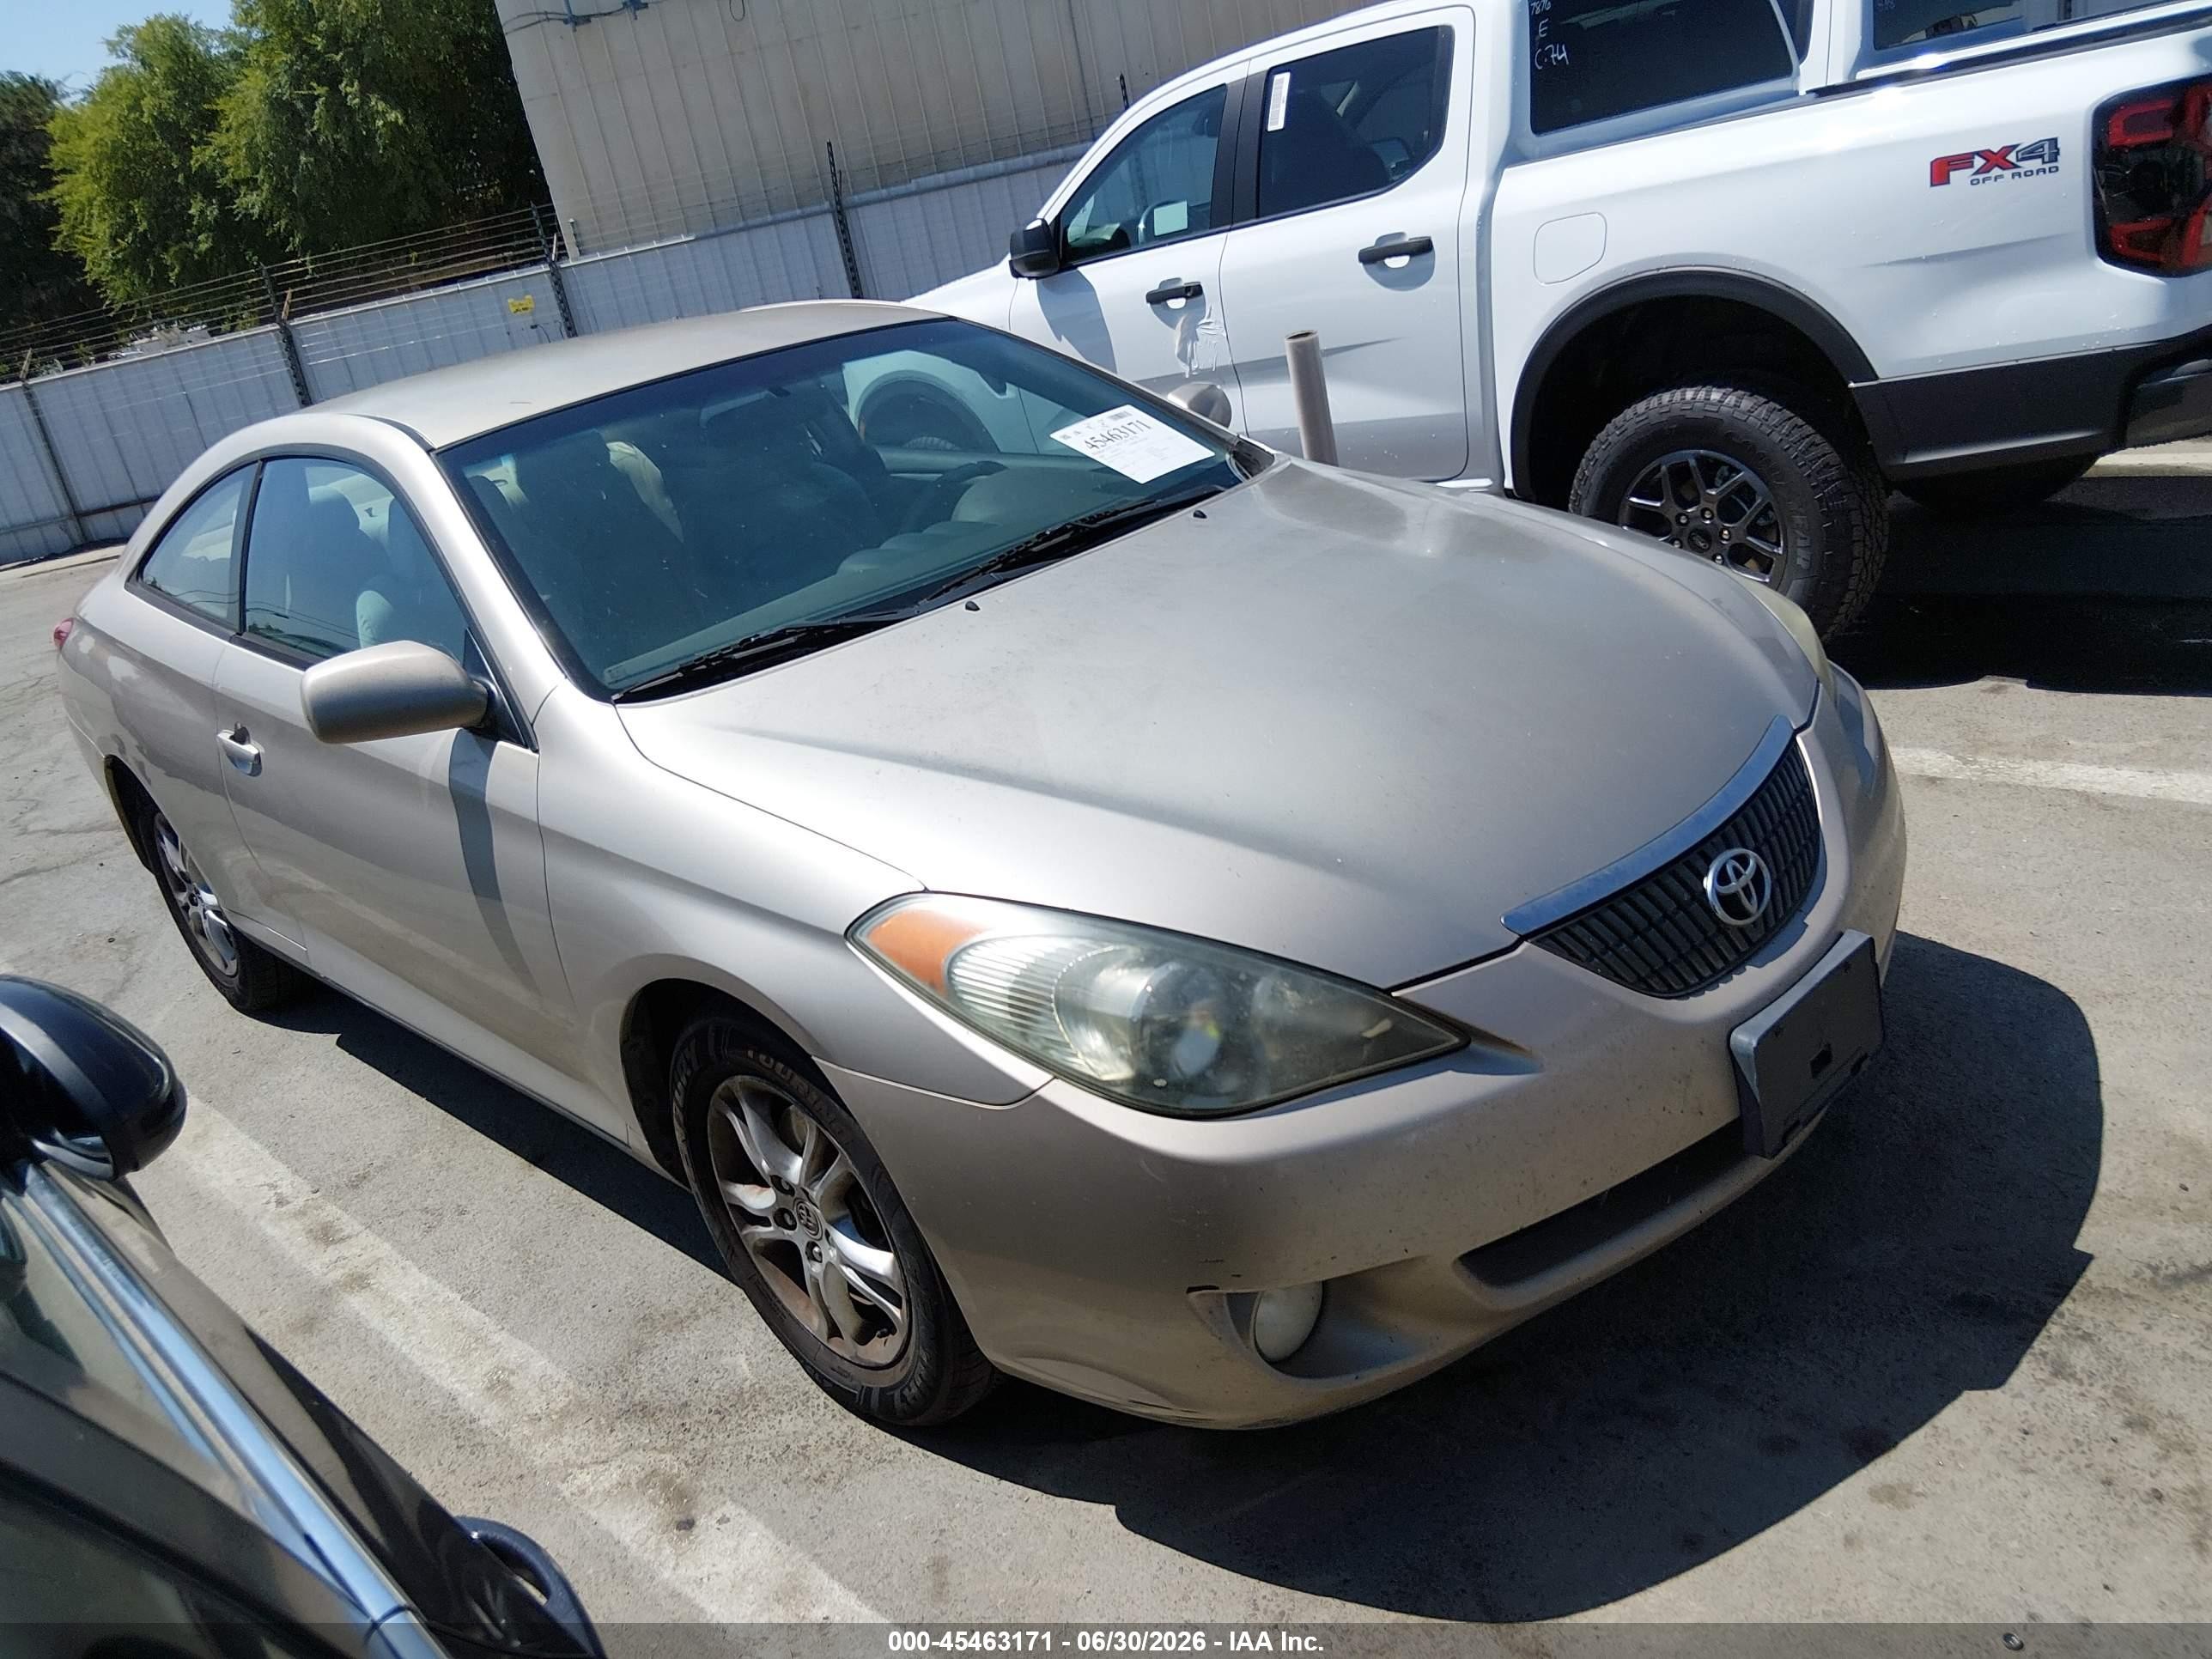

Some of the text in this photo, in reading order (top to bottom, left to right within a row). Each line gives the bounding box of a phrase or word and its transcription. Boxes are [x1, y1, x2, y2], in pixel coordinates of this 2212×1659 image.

[1538, 18, 1549, 38] E
[1929, 137, 2061, 187] FX4
[1970, 165, 2060, 186] OFF ROAD
[1083, 419, 1152, 452] 45463171
